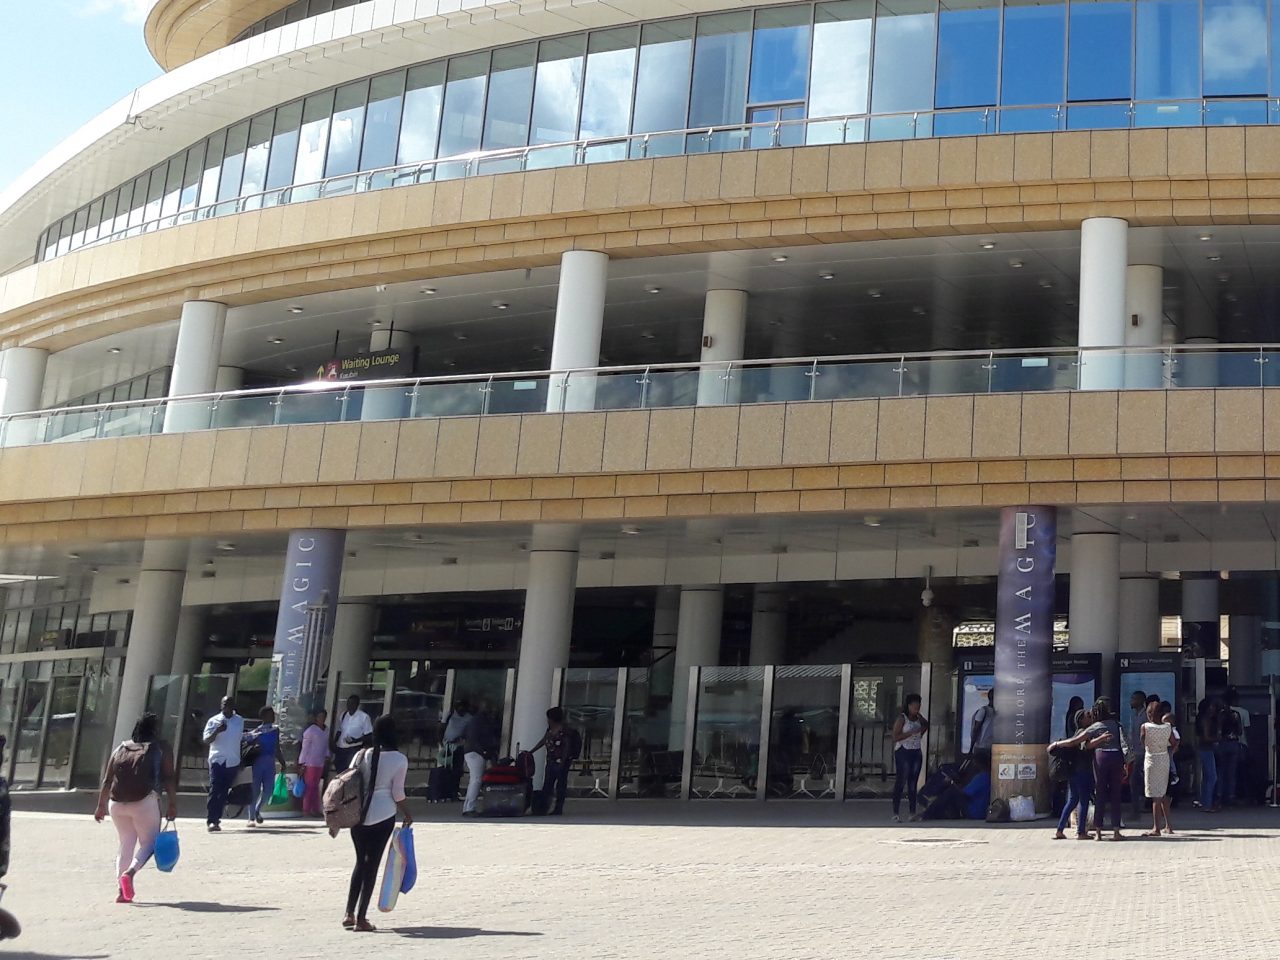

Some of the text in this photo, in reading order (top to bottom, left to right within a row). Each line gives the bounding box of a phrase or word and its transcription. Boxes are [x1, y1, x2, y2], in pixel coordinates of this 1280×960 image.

[341, 354, 400, 369] Waiting Lounge
[288, 537, 315, 645] MAGIC
[286, 650, 297, 677] THE
[1017, 640, 1026, 669] THE
